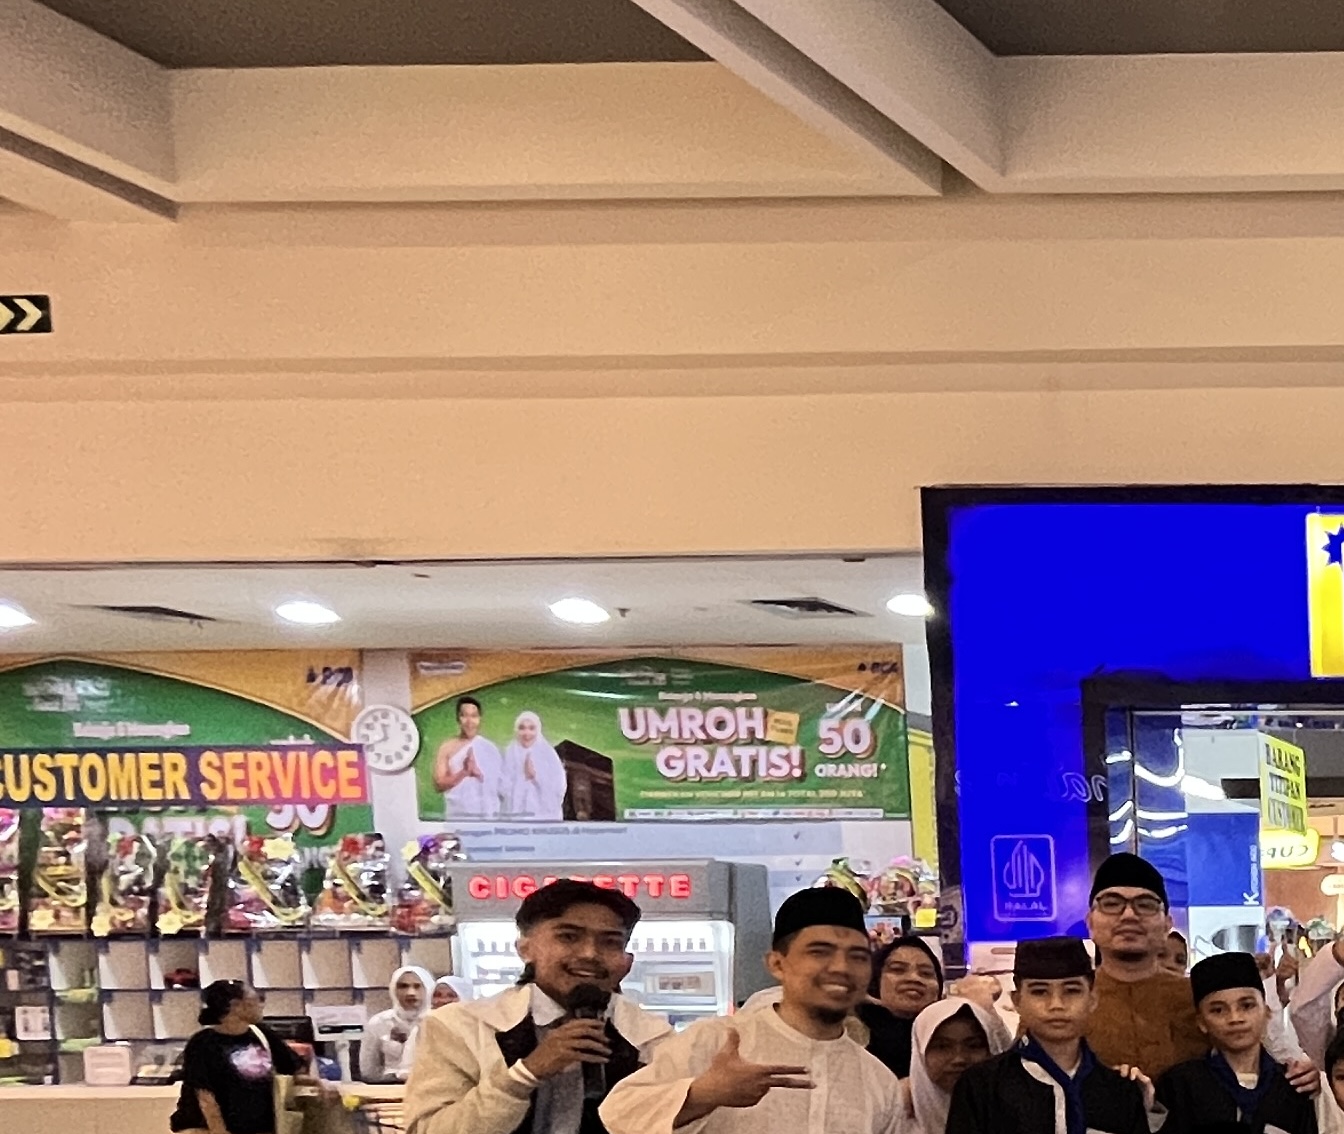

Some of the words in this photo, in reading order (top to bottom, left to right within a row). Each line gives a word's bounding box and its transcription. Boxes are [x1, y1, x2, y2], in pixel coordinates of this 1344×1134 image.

[619, 706, 765, 743] UMROH
[818, 717, 874, 756] 50
[0, 752, 191, 802] USTOMER
[198, 750, 362, 802] SERVICE
[655, 745, 804, 780] GRATIS!
[469, 873, 691, 899] CIGETTE
